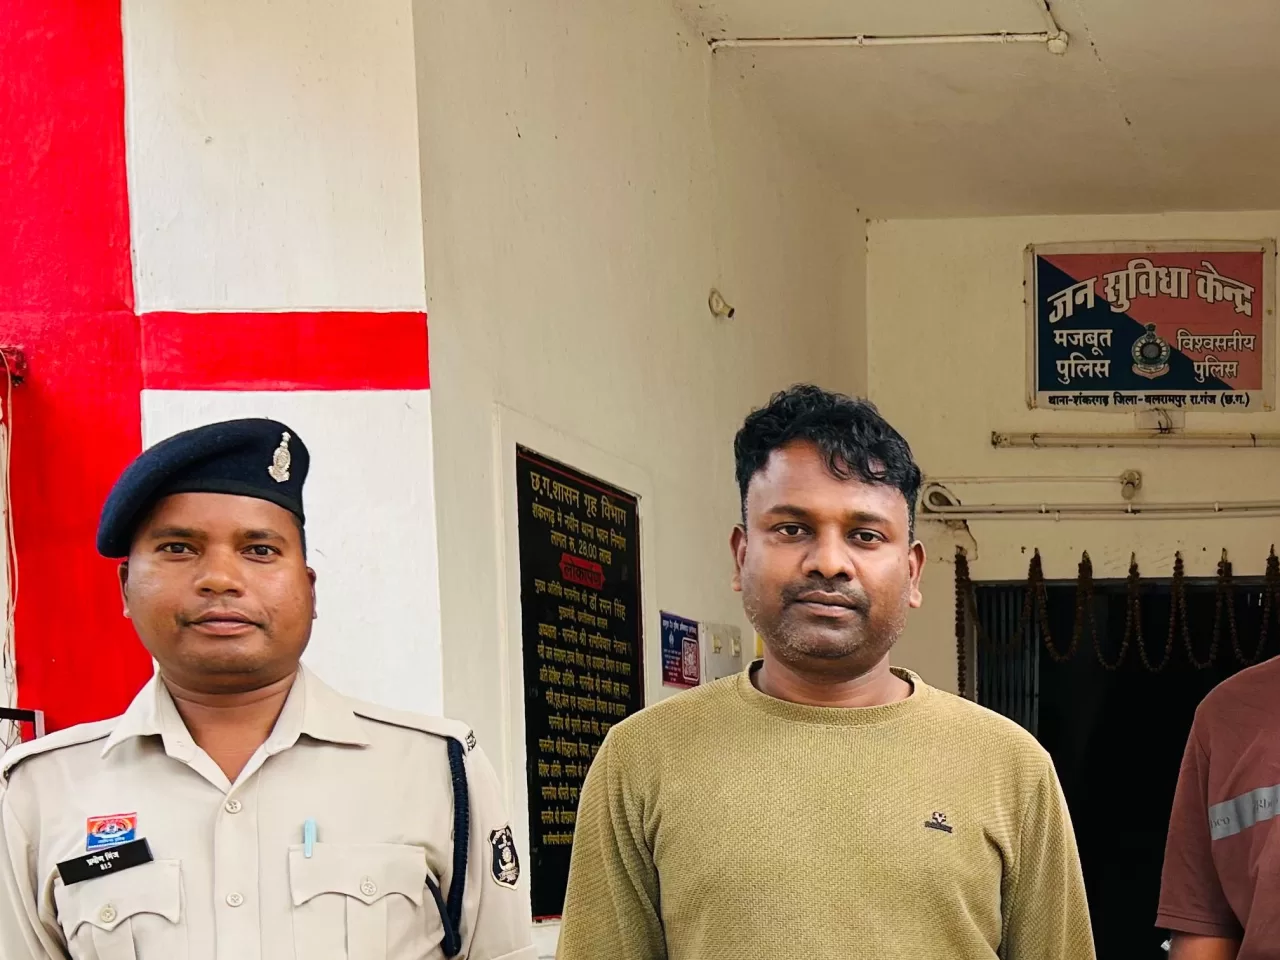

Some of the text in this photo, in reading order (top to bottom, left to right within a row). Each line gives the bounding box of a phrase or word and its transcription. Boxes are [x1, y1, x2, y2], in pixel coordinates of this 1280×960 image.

[1047, 258, 1255, 323] जन सुविधा केन्द्र
[1053, 329, 1113, 355] मजबूत
[1176, 329, 1256, 352] विश्वसनीय
[1056, 352, 1111, 384] पुलिस
[1193, 355, 1239, 383] पुलिस
[584, 493, 598, 518] गृह
[601, 495, 626, 527] विभाग
